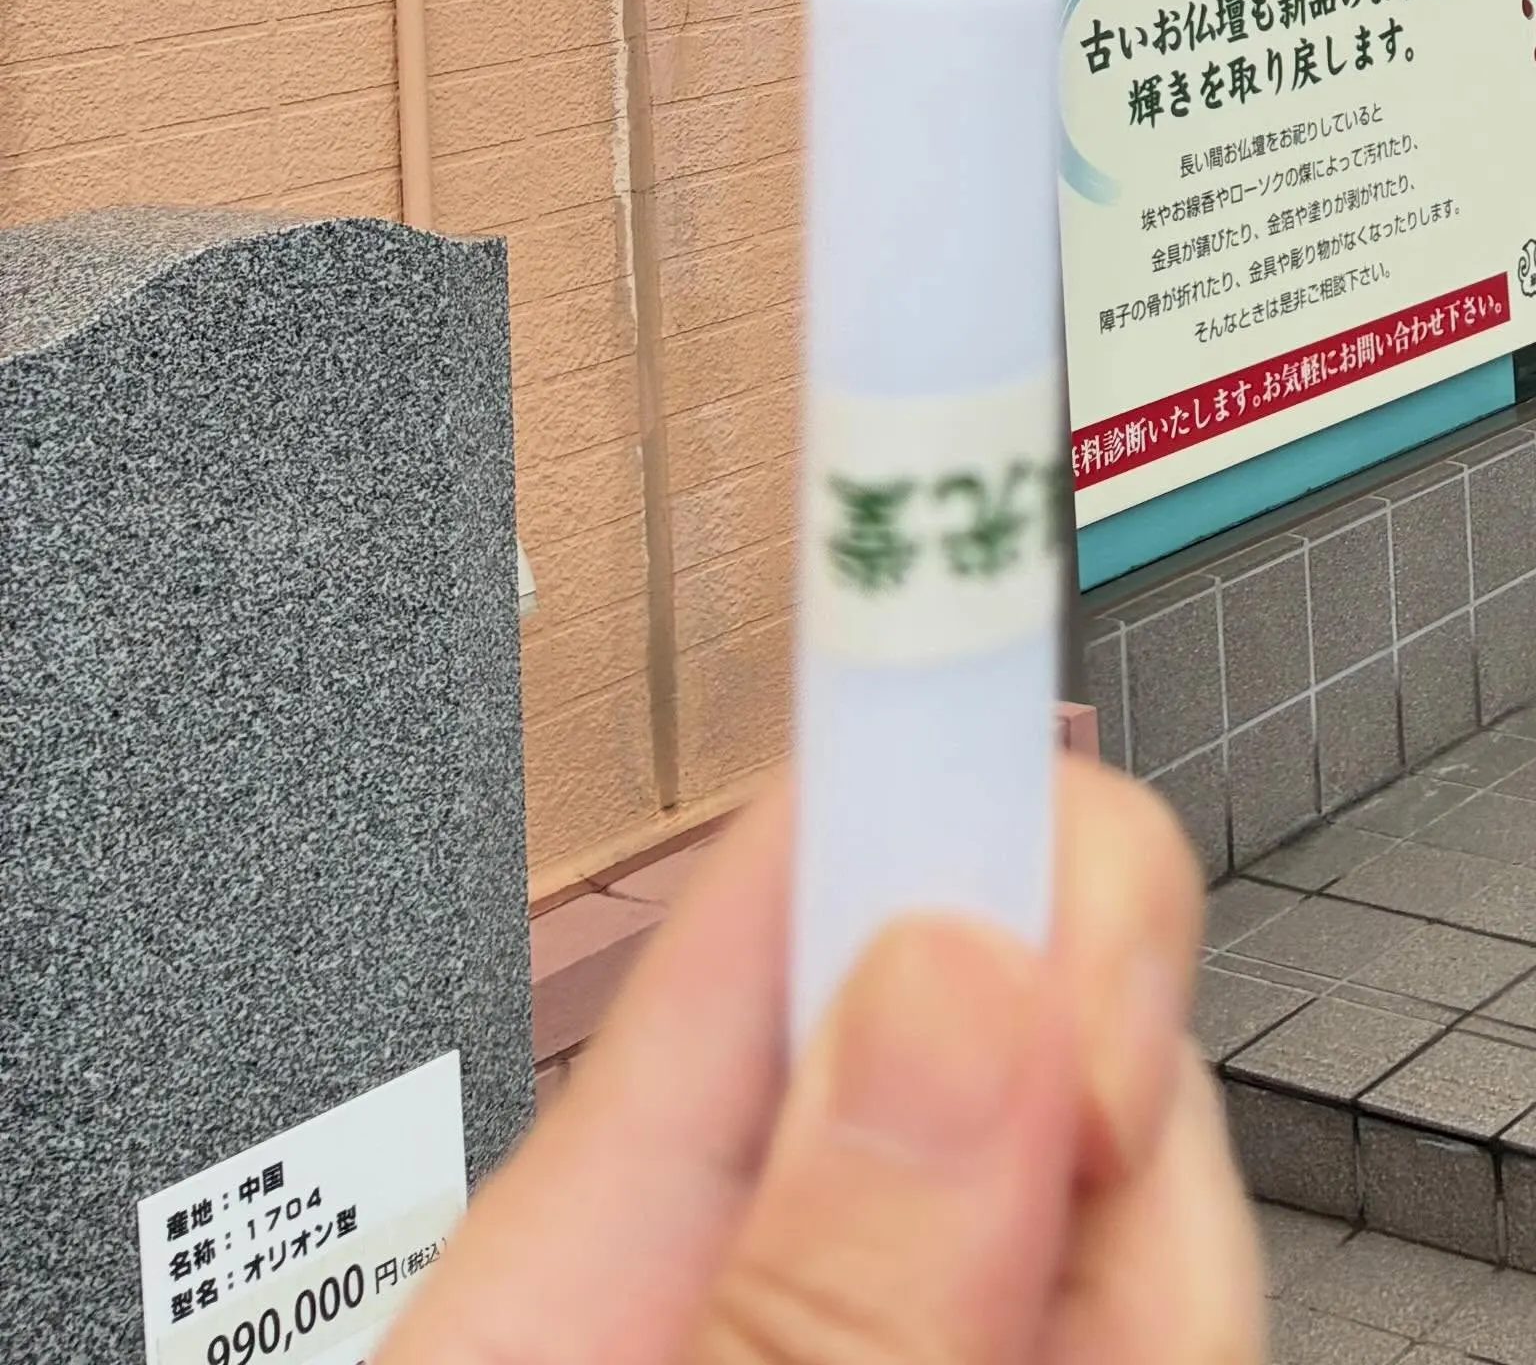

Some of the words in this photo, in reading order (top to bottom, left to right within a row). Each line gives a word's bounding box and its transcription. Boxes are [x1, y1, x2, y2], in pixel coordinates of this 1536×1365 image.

[1128, 17, 1414, 129] 輝きを取り戻します。
[1180, 103, 1384, 179] 長い間お仏壇をお祀りしていると
[1194, 262, 1391, 343] そんなときは是非ご相談下さい。
[171, 1204, 358, 1324] 型名：オリオン型
